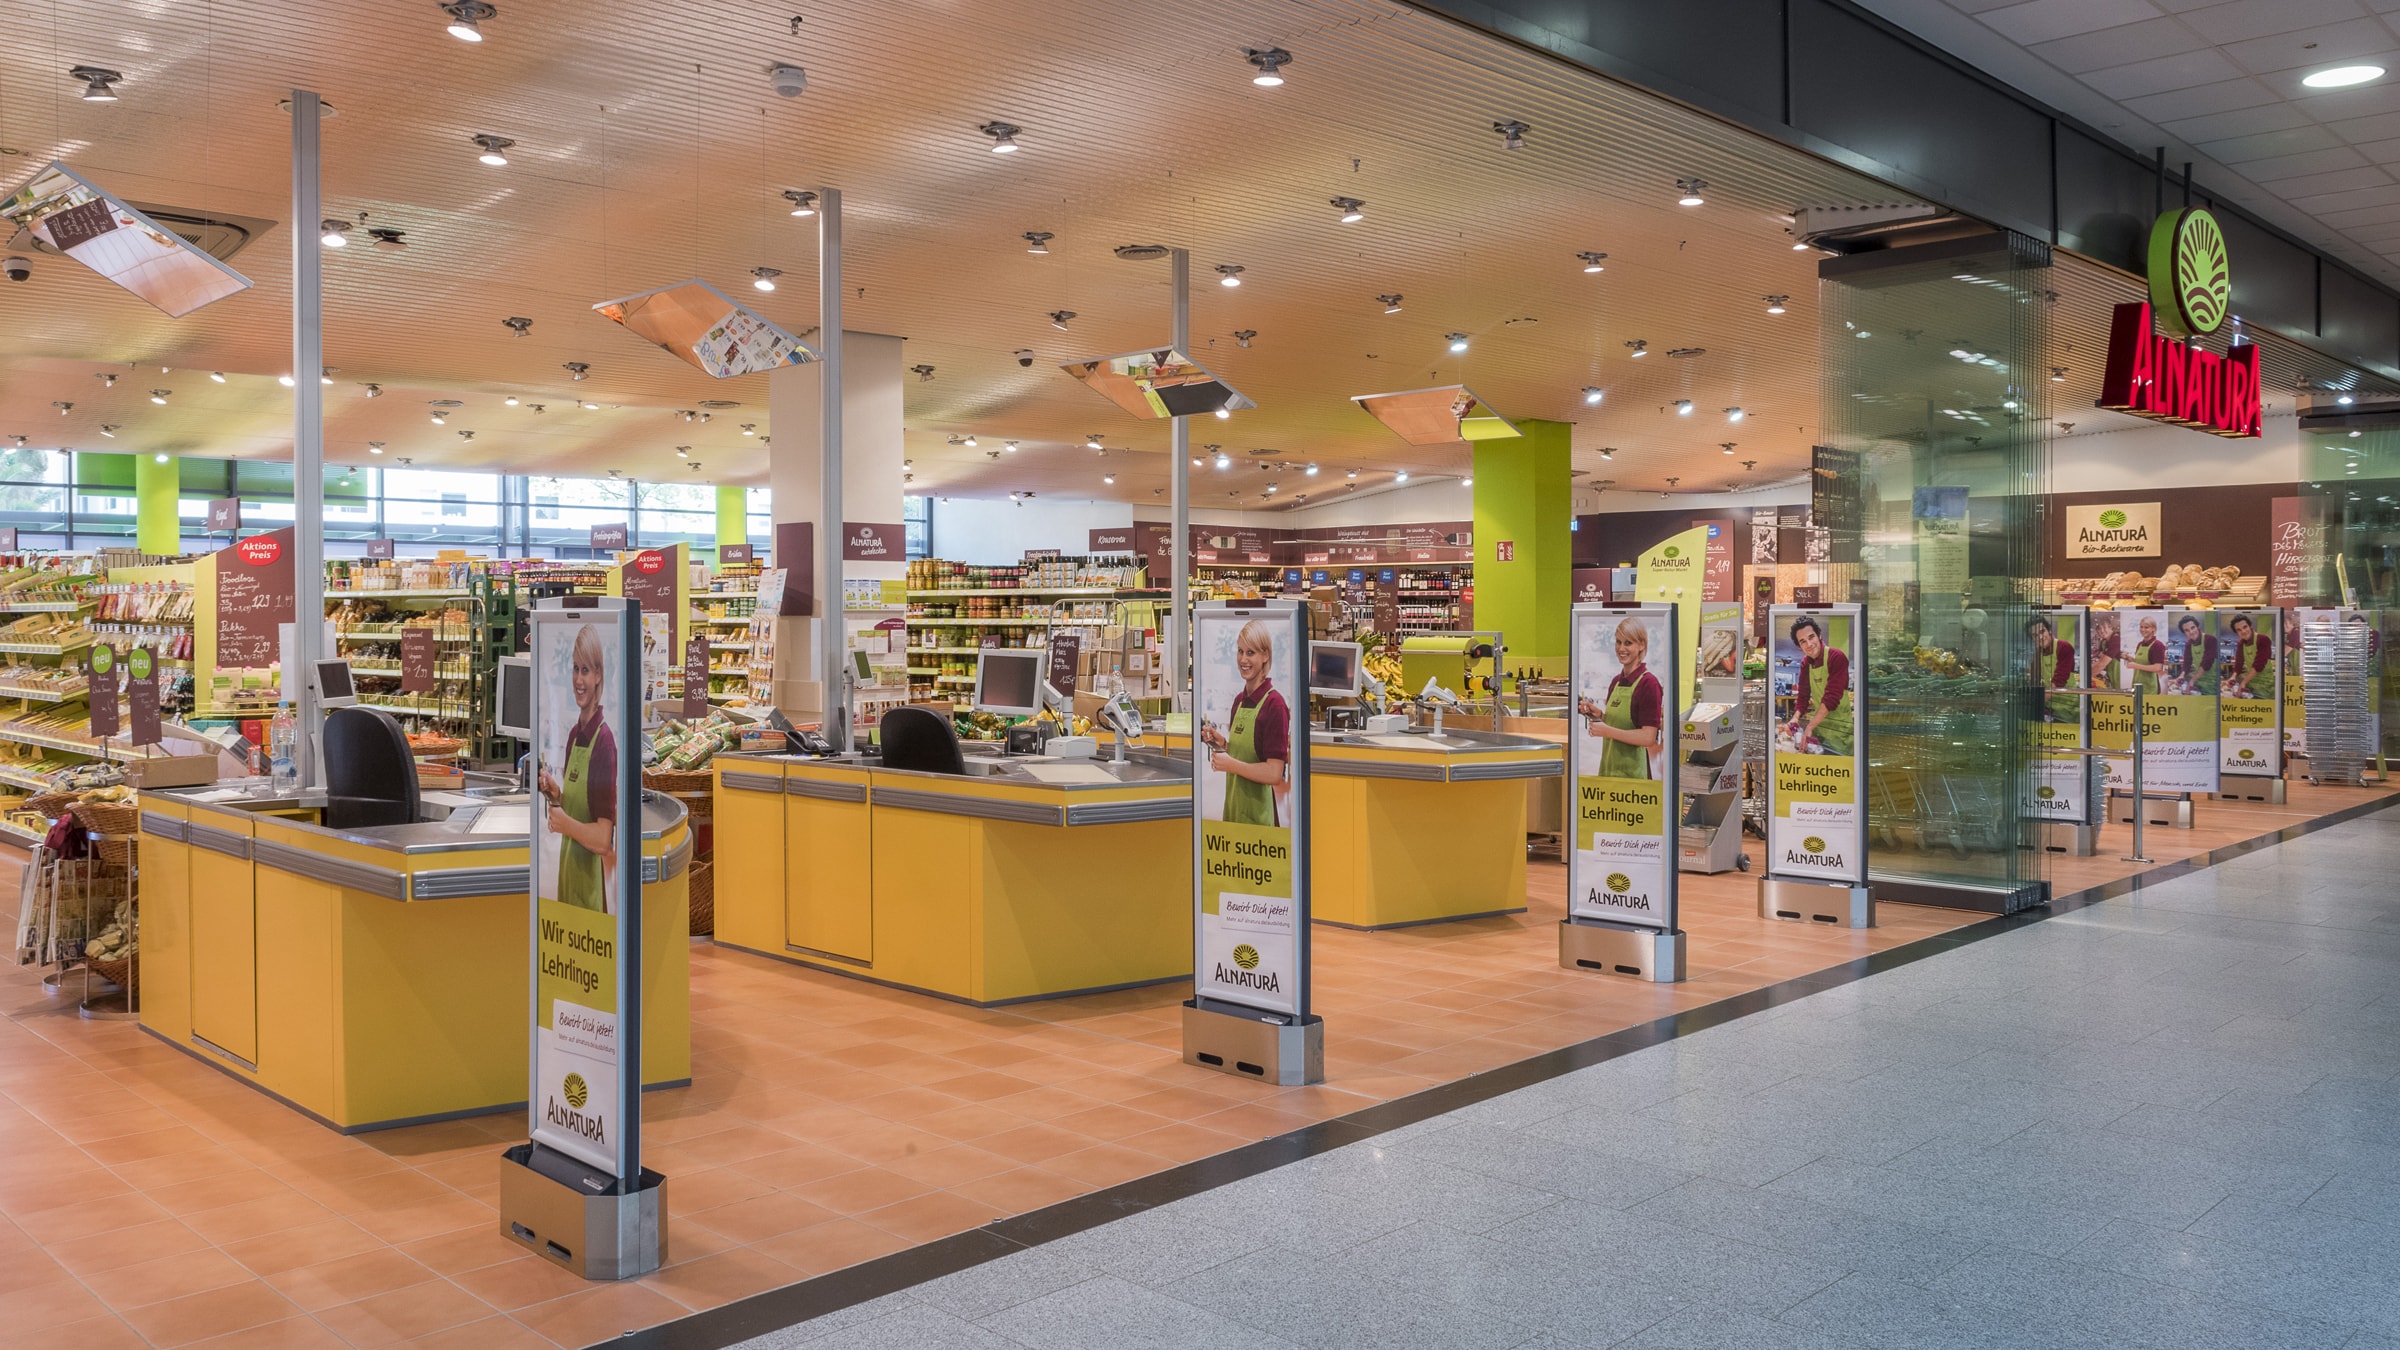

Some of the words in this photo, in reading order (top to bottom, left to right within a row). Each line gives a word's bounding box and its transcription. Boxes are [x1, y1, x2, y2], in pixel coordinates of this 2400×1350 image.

[2129, 302, 2261, 437] ALNATURA
[2079, 526, 2147, 542] ALNATURA
[851, 536, 882, 547] ALNATURA
[250, 551, 271, 559] Preis
[2082, 543, 2144, 554] Bio-Backwaren
[1651, 556, 1690, 567] ALNATURA
[94, 653, 110, 666] neu
[132, 659, 148, 669] neu
[2284, 682, 2296, 692] ir
[2091, 701, 2114, 714] Wir
[2221, 704, 2237, 712] Wir
[2240, 705, 2272, 713] suchen
[2222, 714, 2263, 724] Lehrlinge
[1680, 733, 1706, 741] LNATURA
[2038, 731, 2076, 740] suchen
[2142, 747, 2166, 755] ewirb
[2167, 747, 2186, 755] Dich
[2186, 747, 2209, 758] jetzt!
[2226, 758, 2267, 768] ALNATURA
[1779, 763, 1801, 775] Wir
[1805, 765, 1850, 778] suchen
[1780, 780, 1837, 796] Lehrlinge
[1582, 787, 1605, 800] Wir
[1610, 790, 1658, 805] suchen
[1582, 806, 1644, 826] Lehrlinge
[1797, 807, 1818, 815] Bewirb
[1833, 809, 1852, 818] jetzt!
[1206, 834, 1230, 852] Wir
[1235, 840, 1286, 859] suchen
[1600, 839, 1623, 848] Bewirb
[1624, 840, 1639, 849] Dich
[1640, 841, 1660, 852] jetzt!
[1680, 855, 1705, 865] ournal
[1786, 849, 1844, 868] ALNATURA
[1207, 859, 1272, 885] Lehrlinge
[1588, 888, 1650, 910] ALNATURA
[1227, 901, 1252, 912] Bewirb
[1252, 903, 1267, 915] Dich
[1268, 905, 1289, 919] jetzt!
[542, 918, 564, 941] Wir
[568, 929, 612, 959] suchen
[542, 952, 598, 993] Lehrlinge
[1215, 962, 1280, 993] ALNATURA
[559, 1012, 581, 1028] Bewirb
[582, 1018, 595, 1034] Dich
[595, 1022, 614, 1040] jetzt!
[547, 1095, 604, 1144] ALNATURA
